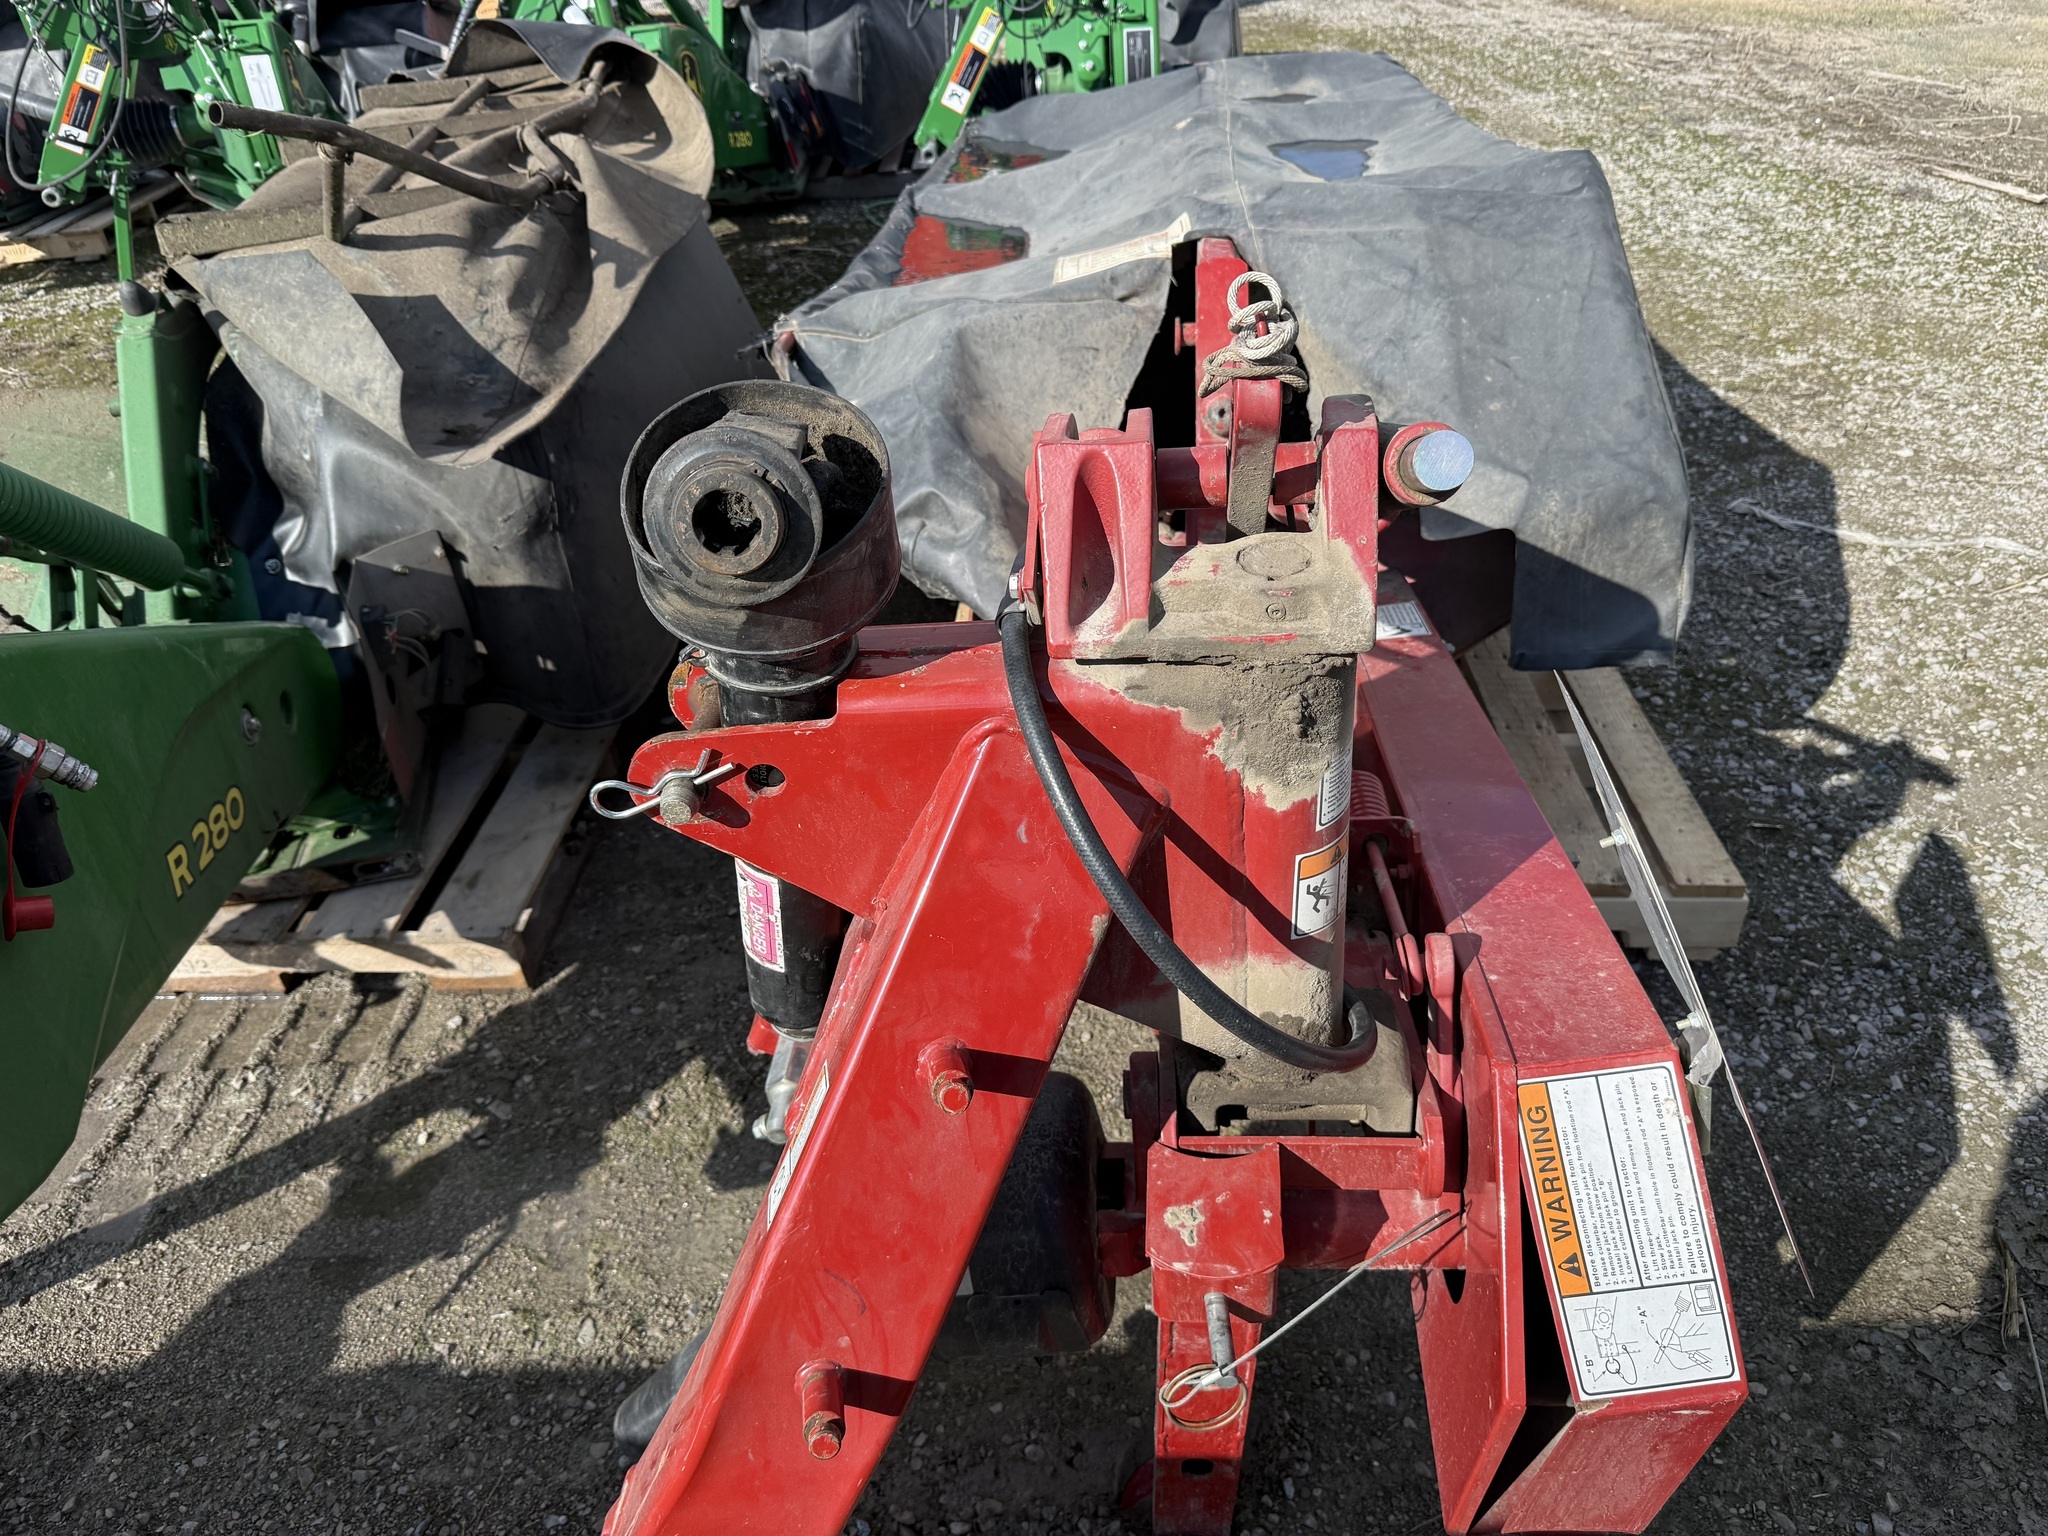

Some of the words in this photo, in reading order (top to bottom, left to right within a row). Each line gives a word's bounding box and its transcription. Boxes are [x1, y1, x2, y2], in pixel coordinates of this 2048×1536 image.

[166, 842, 194, 899] R
[191, 786, 244, 872] 280
[1650, 1081, 1657, 1091] or
[1617, 1096, 1626, 1110] jack
[1652, 1093, 1663, 1119] death
[1569, 1113, 1579, 1143] flotation
[1623, 1127, 1632, 1142] jack
[1639, 1128, 1647, 1140] rod
[1658, 1122, 1666, 1130] in
[1561, 1126, 1571, 1156] tractor:
[1660, 1133, 1672, 1160] result
[1575, 1144, 1583, 1161] from
[1627, 1143, 1637, 1169] remove
[1643, 1141, 1653, 1170] flotation
[1526, 1105, 1572, 1242] WARNING
[1567, 1158, 1576, 1177] from
[1619, 1156, 1630, 1187] tractor:
[1632, 1171, 1640, 1184] and
[1666, 1163, 1678, 1189] could
[1571, 1179, 1580, 1195] unit
[1581, 1175, 1590, 1190] jack
[1651, 1180, 1659, 1196] hole
[1626, 1189, 1632, 1197] to
[1636, 1186, 1644, 1203] arms
[1585, 1191, 1595, 1218] remove
[1603, 1204, 1612, 1219] jack
[1613, 1208, 1619, 1216] to
[1627, 1200, 1636, 1216] unit
[1654, 1197, 1663, 1213] until
[1674, 1192, 1686, 1226] comply
[1576, 1198, 1593, 1256] disconnecting
[1606, 1220, 1615, 1234] and
[1615, 1218, 1626, 1250] cutterbar
[1642, 1217, 1656, 1257] three-point
[1659, 1216, 1670, 1247] cutterbar
[1670, 1229, 1679, 1244] jack
[1682, 1229, 1689, 1238] to
[1601, 1230, 1610, 1245] jack
[1610, 1236, 1620, 1251] jack
[1632, 1218, 1646, 1257] mounting
[1605, 1247, 1616, 1276] Remove
[1614, 1252, 1624, 1275] Install
[1623, 1252, 1632, 1274] Lower
[1659, 1252, 1667, 1270] Stow
[1666, 1249, 1675, 1269] Raise
[1673, 1246, 1683, 1268] Install
[1685, 1241, 1697, 1274] Failure
[1694, 1237, 1707, 1273] serious
[1589, 1259, 1601, 1286] Before
[1600, 1256, 1608, 1277] Raise
[1642, 1260, 1651, 1280] After
